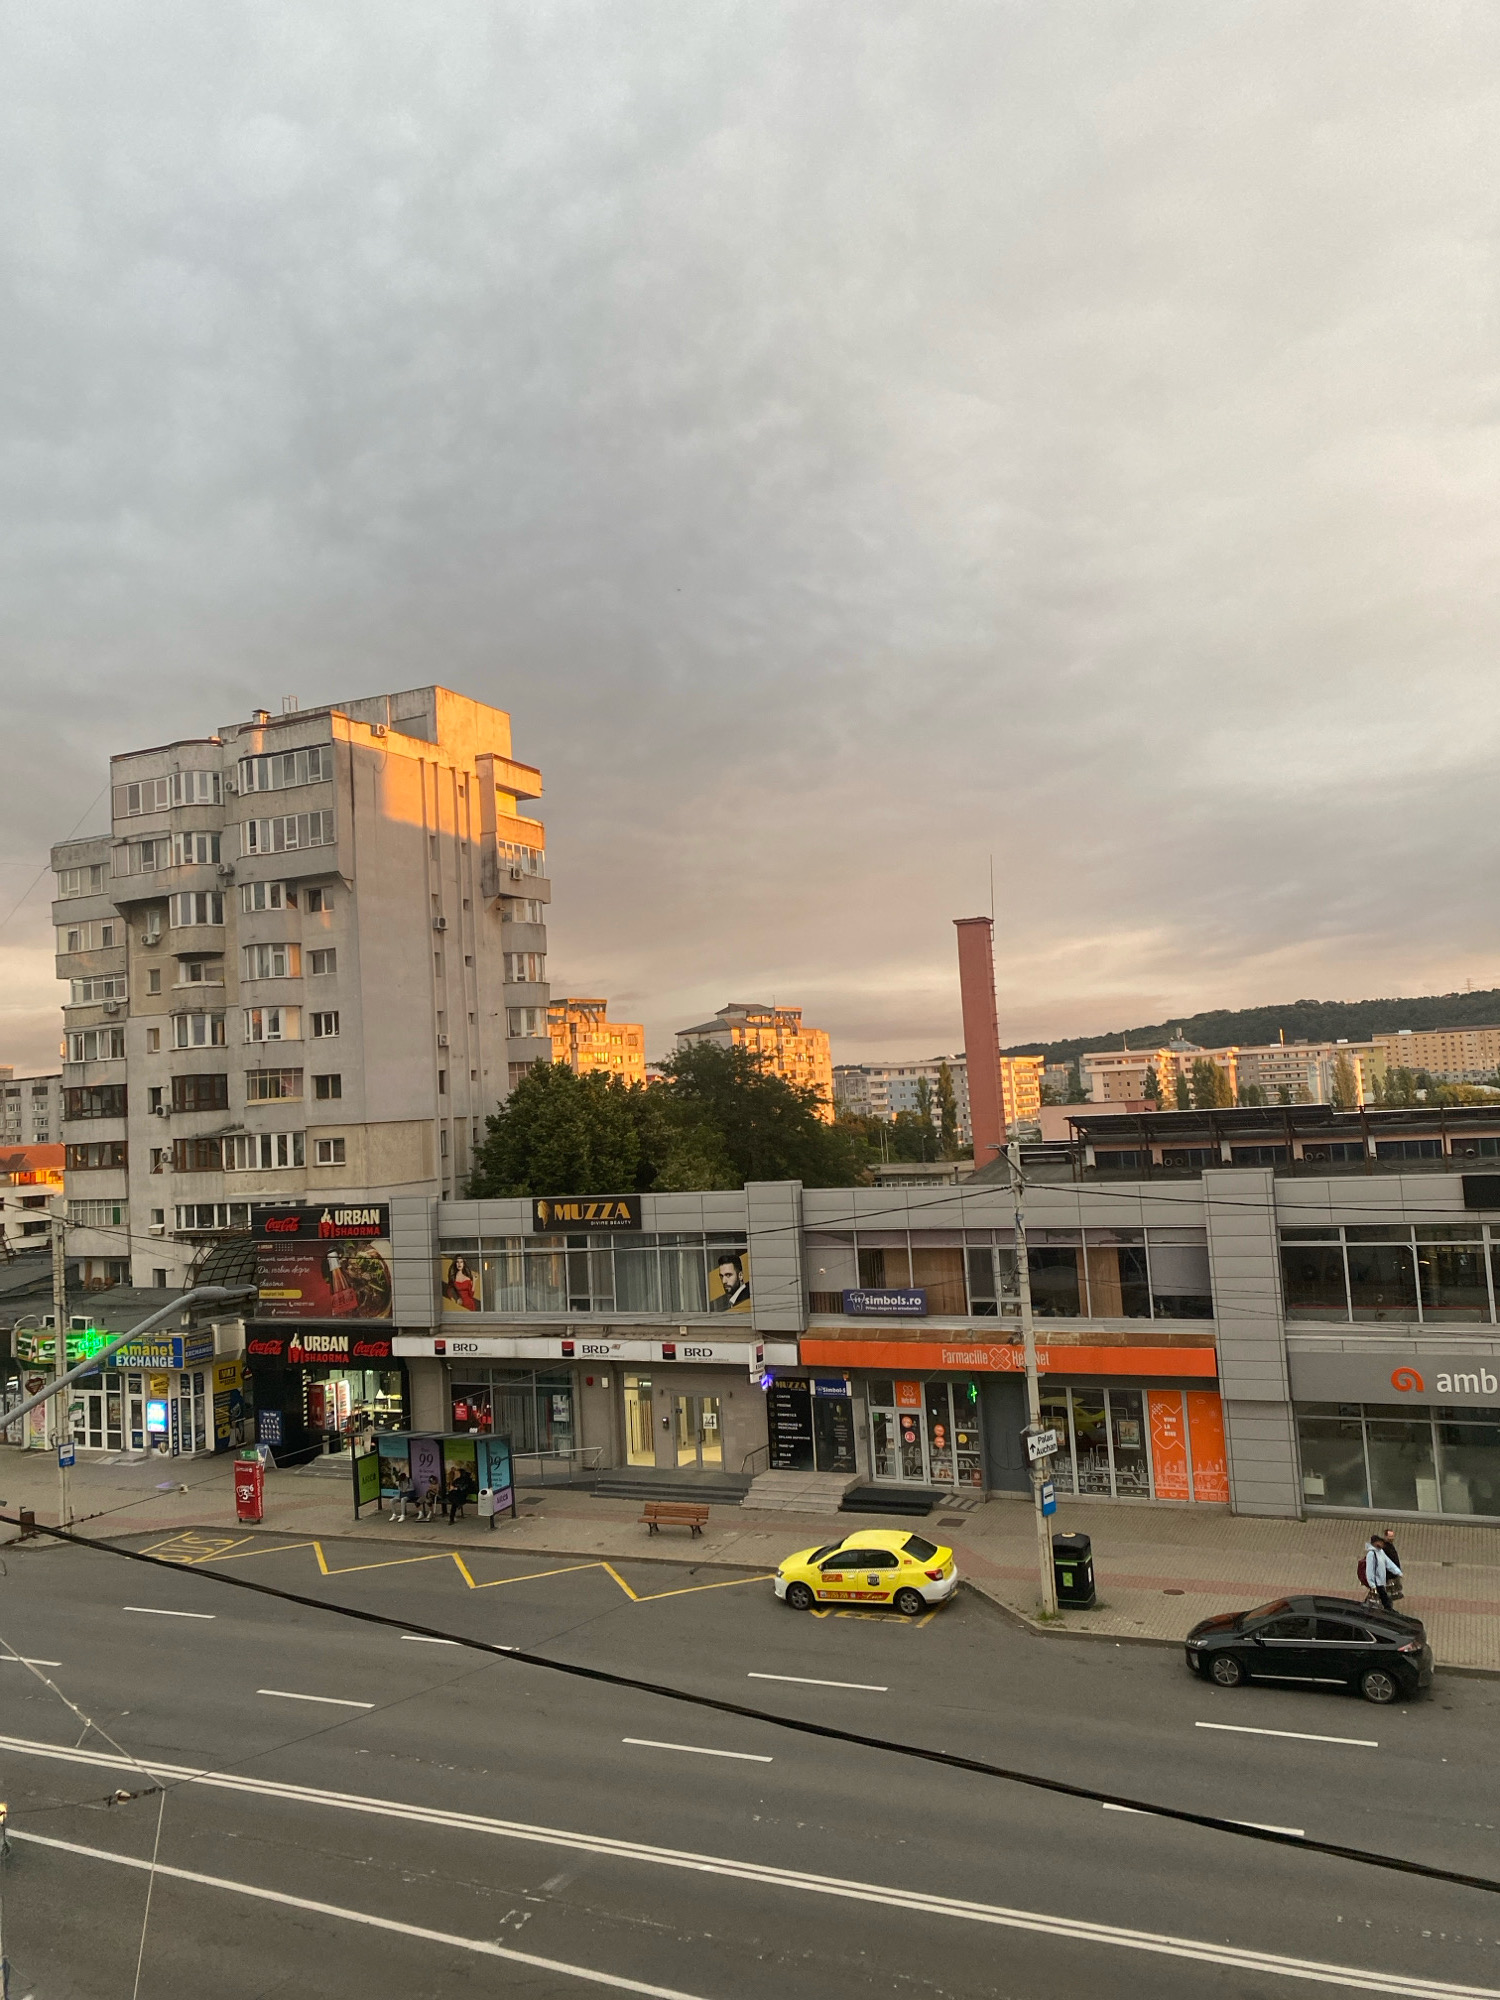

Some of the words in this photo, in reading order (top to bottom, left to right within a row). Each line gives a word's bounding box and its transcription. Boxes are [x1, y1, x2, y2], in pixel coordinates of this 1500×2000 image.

[334, 1208, 380, 1226] URBAN
[554, 1202, 631, 1221] MUZZA
[334, 1226, 381, 1236] SHAORMA
[864, 1295, 922, 1305] simbols.ro
[303, 1335, 349, 1352] URBAN
[452, 1343, 478, 1352] BRD
[582, 1345, 610, 1354] BRD
[116, 1343, 174, 1357] Amanet
[185, 1345, 213, 1358] EXCHANGE
[684, 1347, 713, 1358] BRD
[116, 1356, 175, 1368] EXCHANGE
[304, 1353, 350, 1363] SHAORMA
[941, 1348, 989, 1365] Farmaciile
[775, 1380, 808, 1390] MUZZA
[1436, 1367, 1498, 1394] amb
[1037, 1433, 1054, 1445] Palas
[1036, 1443, 1057, 1456] Auchan
[418, 1453, 434, 1467] 99
